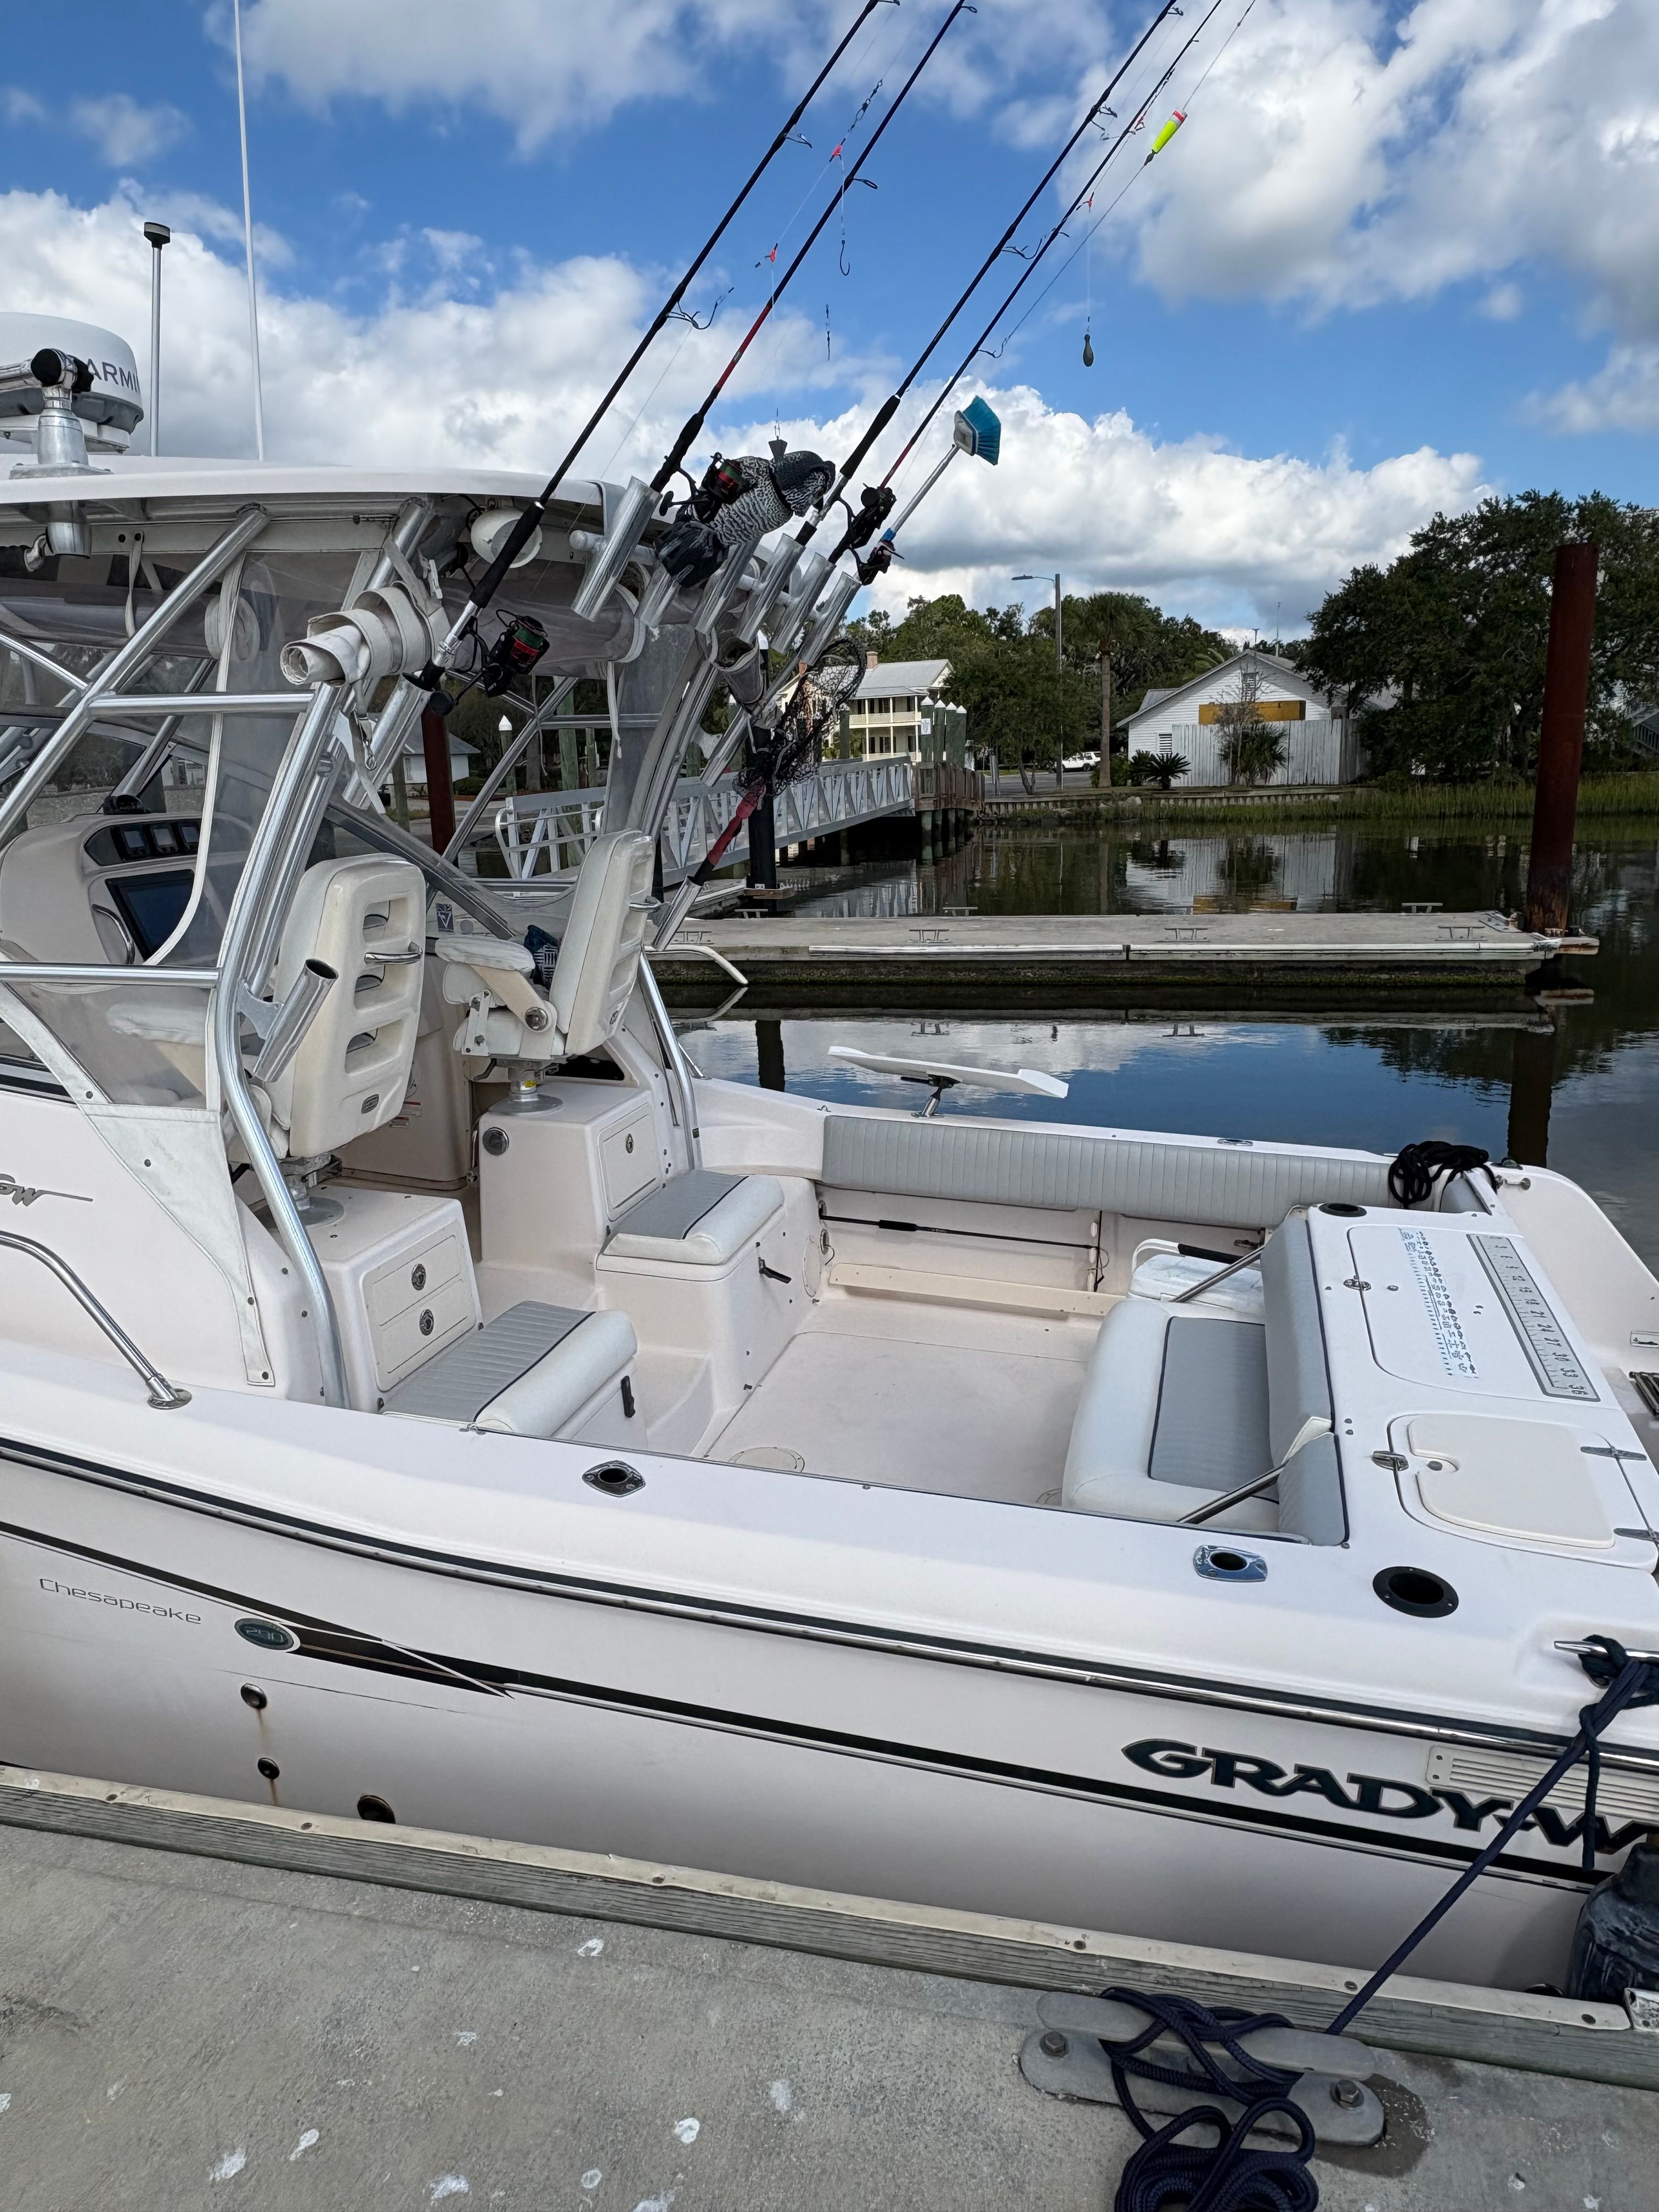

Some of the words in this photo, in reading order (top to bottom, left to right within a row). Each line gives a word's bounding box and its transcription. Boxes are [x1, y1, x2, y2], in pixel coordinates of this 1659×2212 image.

[87, 358, 140, 393] ARMI
[1537, 1323, 1555, 1332] 24
[1544, 1337, 1561, 1347] 27
[1552, 1352, 1571, 1362] 30
[1560, 1368, 1579, 1378] 33
[1568, 1384, 1589, 1395] 36
[39, 1578, 201, 1624] Chesapeake
